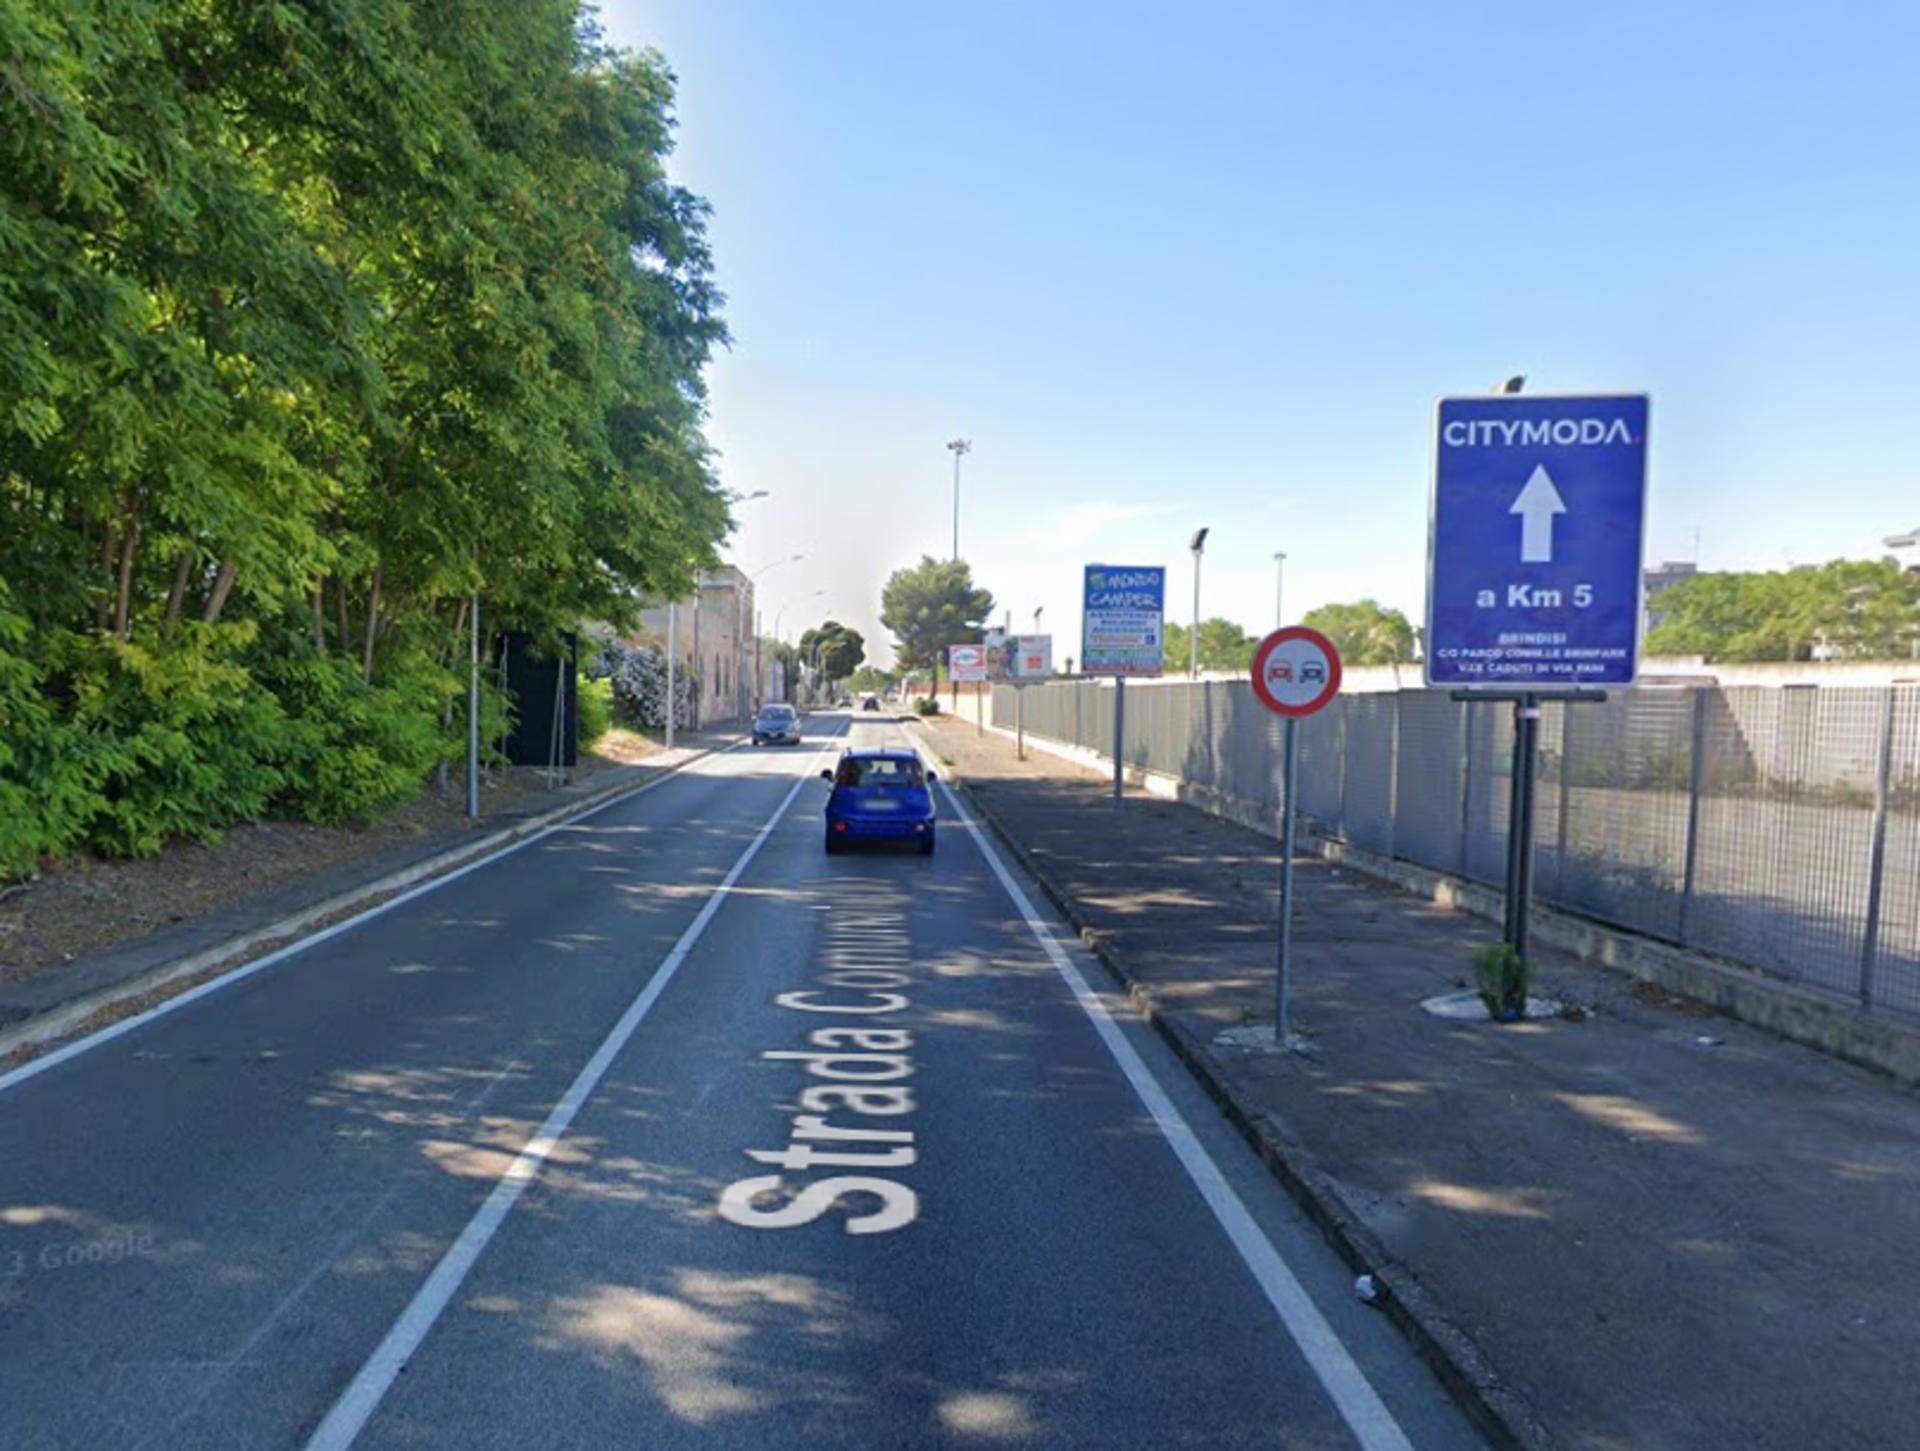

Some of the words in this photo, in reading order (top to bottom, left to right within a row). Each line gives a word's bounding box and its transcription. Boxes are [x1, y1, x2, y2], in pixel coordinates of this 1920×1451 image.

[1443, 418, 1632, 447] CITYMODA
[1476, 590, 1496, 608] a
[1507, 584, 1562, 608] Km
[1573, 584, 1593, 608] 5
[1499, 632, 1567, 645] BRINDISI
